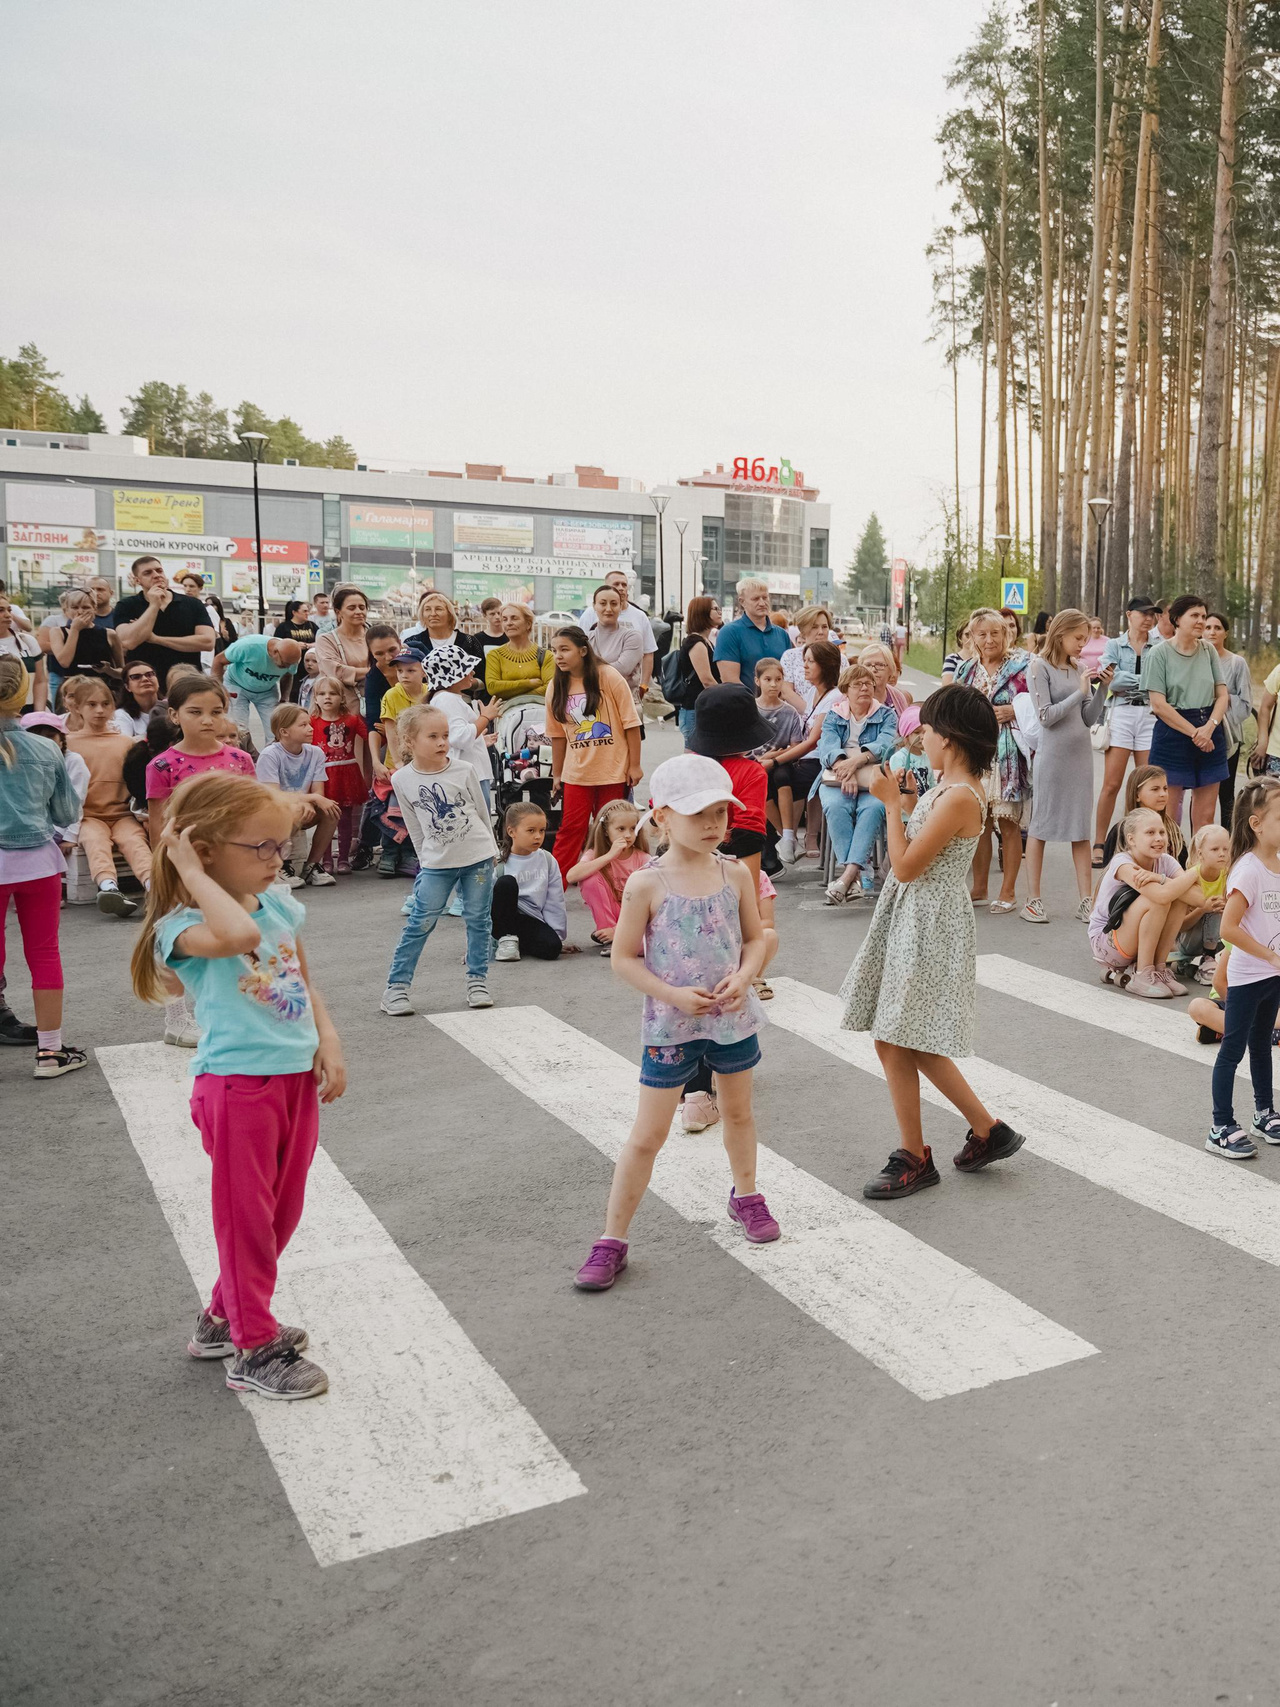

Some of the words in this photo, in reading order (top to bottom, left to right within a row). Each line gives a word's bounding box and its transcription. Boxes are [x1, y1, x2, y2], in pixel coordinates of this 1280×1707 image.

[116, 491, 161, 504] Эконом
[164, 495, 200, 509] Тренд
[13, 531, 68, 543] ЗАГЛЯНИ
[127, 538, 166, 549] СОЧНОЙ
[168, 541, 219, 552] КУРОЧКОЙ
[262, 544, 289, 554] KFC
[461, 553, 511, 563] АРЕНДА
[513, 556, 589, 568] РЕКЛАМНЫХ
[591, 561, 624, 569] МЕСТ
[482, 563, 490, 571] 8
[495, 564, 521, 572] 922
[526, 565, 552, 574] 294
[557, 567, 574, 576] 57
[579, 568, 594, 577] 51
[570, 740, 591, 749] STAY
[257, 1345, 284, 1361] SPORT
